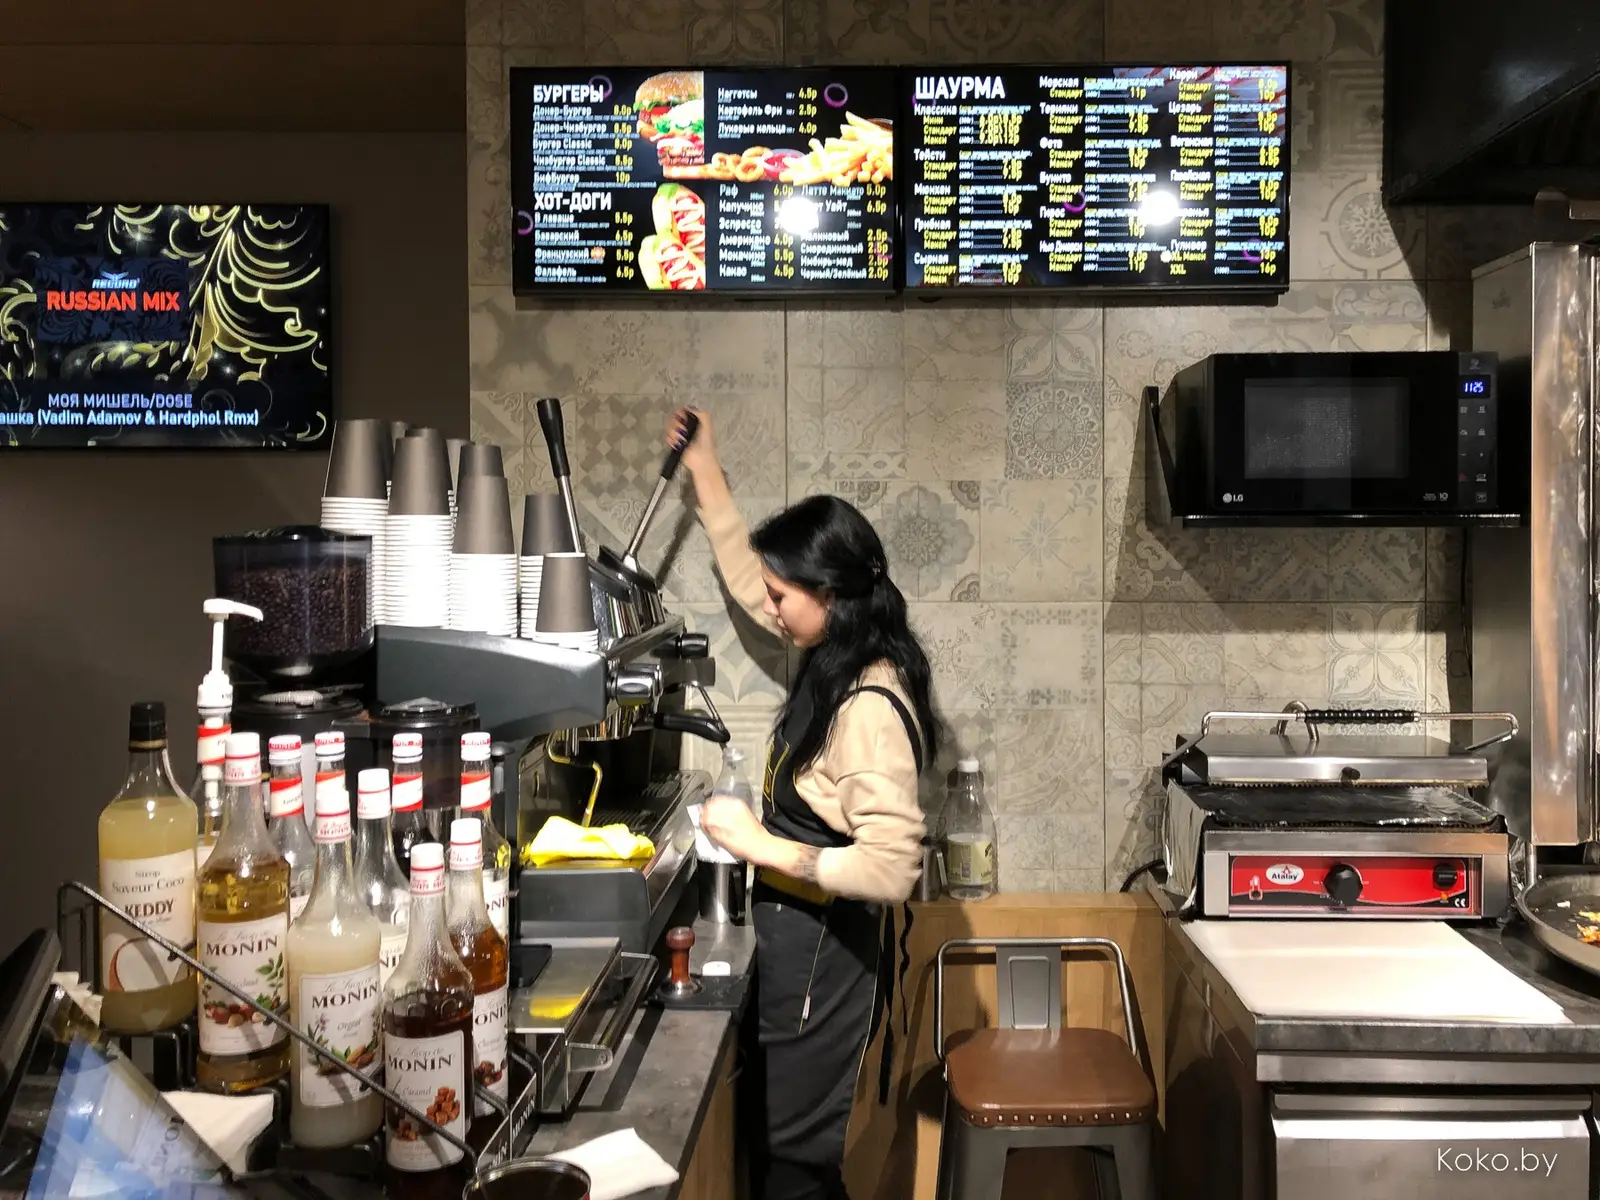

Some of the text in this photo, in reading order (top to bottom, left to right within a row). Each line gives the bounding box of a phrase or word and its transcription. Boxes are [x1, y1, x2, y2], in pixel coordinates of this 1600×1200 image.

[1169, 68, 1198, 82] Карри
[915, 76, 1006, 99] ШАУРМА
[1040, 76, 1079, 89] Морская
[533, 84, 603, 103] БУРГЕРЫ
[1050, 88, 1083, 99] Стандарт
[718, 104, 763, 118] Картофель
[764, 104, 782, 118] Фри
[914, 103, 957, 115] Классика
[1040, 102, 1078, 115] Терияки
[1168, 101, 1202, 114] Цезарь
[533, 139, 561, 151] Бургер
[1040, 137, 1063, 149] Фета
[914, 148, 946, 161] Тейсти
[719, 184, 794, 200] Раф 6.0р
[914, 183, 951, 195] Мюнхен
[534, 192, 612, 213] ХОТ-ДОГИ
[719, 200, 764, 214] Капучино
[825, 199, 847, 213] Уайт
[719, 217, 762, 232] Эспрессо
[914, 218, 951, 232] Грибная
[535, 229, 580, 241] Баварский
[719, 233, 793, 248] Американо 4.0р
[719, 250, 766, 263] Мокачино
[801, 242, 864, 257] Смородиновый
[801, 255, 853, 270] Имбирь-мед
[914, 252, 949, 265] Сырная
[535, 265, 577, 279] Фалафель
[719, 264, 747, 278] Какао
[1170, 264, 1186, 275] XXL
[47, 291, 180, 312] RUSSIAN MIX
[48, 393, 193, 409] МОЯ МИШЕЛЬ/DOSE
[38, 410, 84, 426] (Vadim
[87, 411, 141, 425] Adamov
[145, 411, 156, 425] &
[159, 410, 221, 428] Hardphol
[225, 410, 259, 426] Rmx)
[1271, 872, 1298, 881] Atalay
[112, 876, 185, 895] Saveur Coco
[124, 899, 174, 918] KEDDY
[206, 935, 278, 957] MONIN
[312, 982, 378, 1009] MONIN
[387, 1054, 453, 1072] MONIN
